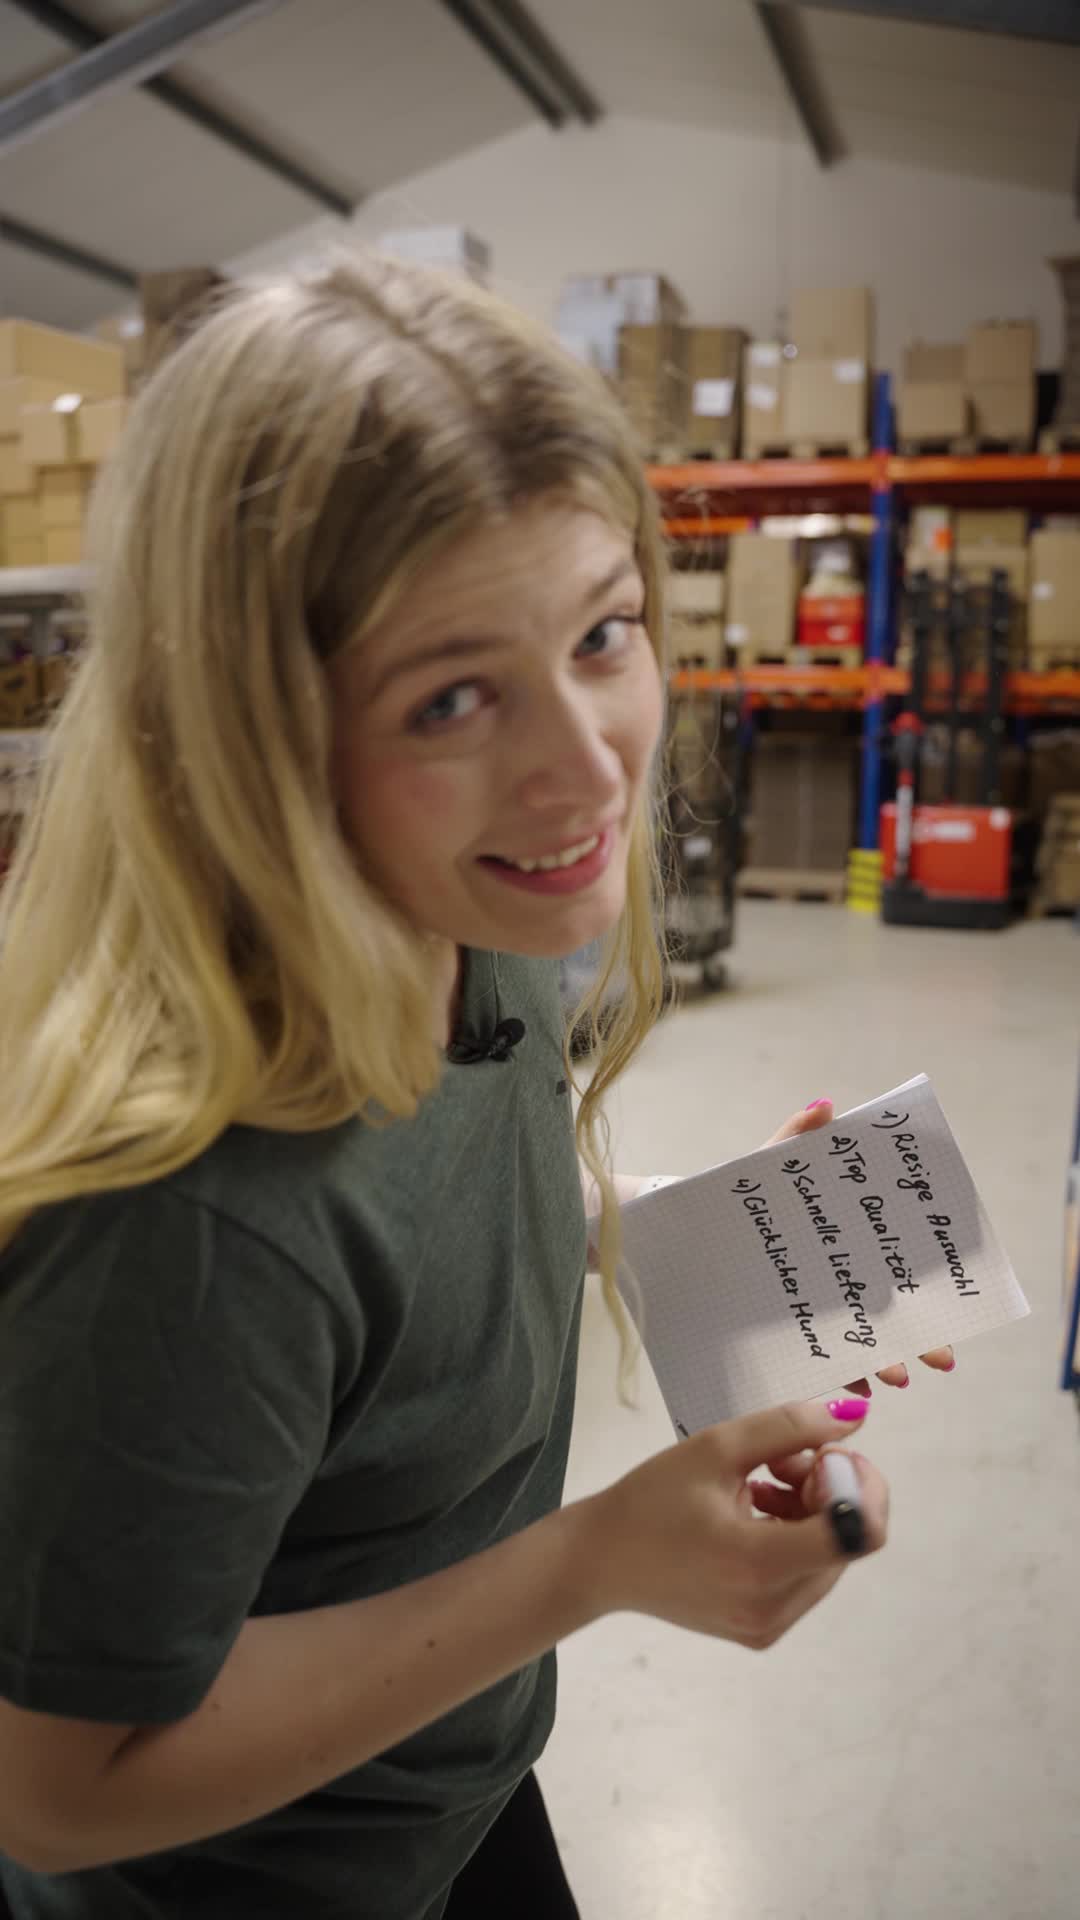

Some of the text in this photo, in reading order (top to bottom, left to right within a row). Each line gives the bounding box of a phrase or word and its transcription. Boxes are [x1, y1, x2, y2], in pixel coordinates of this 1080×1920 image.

[838, 1151, 867, 1183] Top
[859, 1195, 920, 1295] Qualität
[871, 1110, 981, 1297] 1) Riesige Auswahl
[789, 1302, 831, 1359] Hund
[828, 1253, 877, 1348] Lieferung
